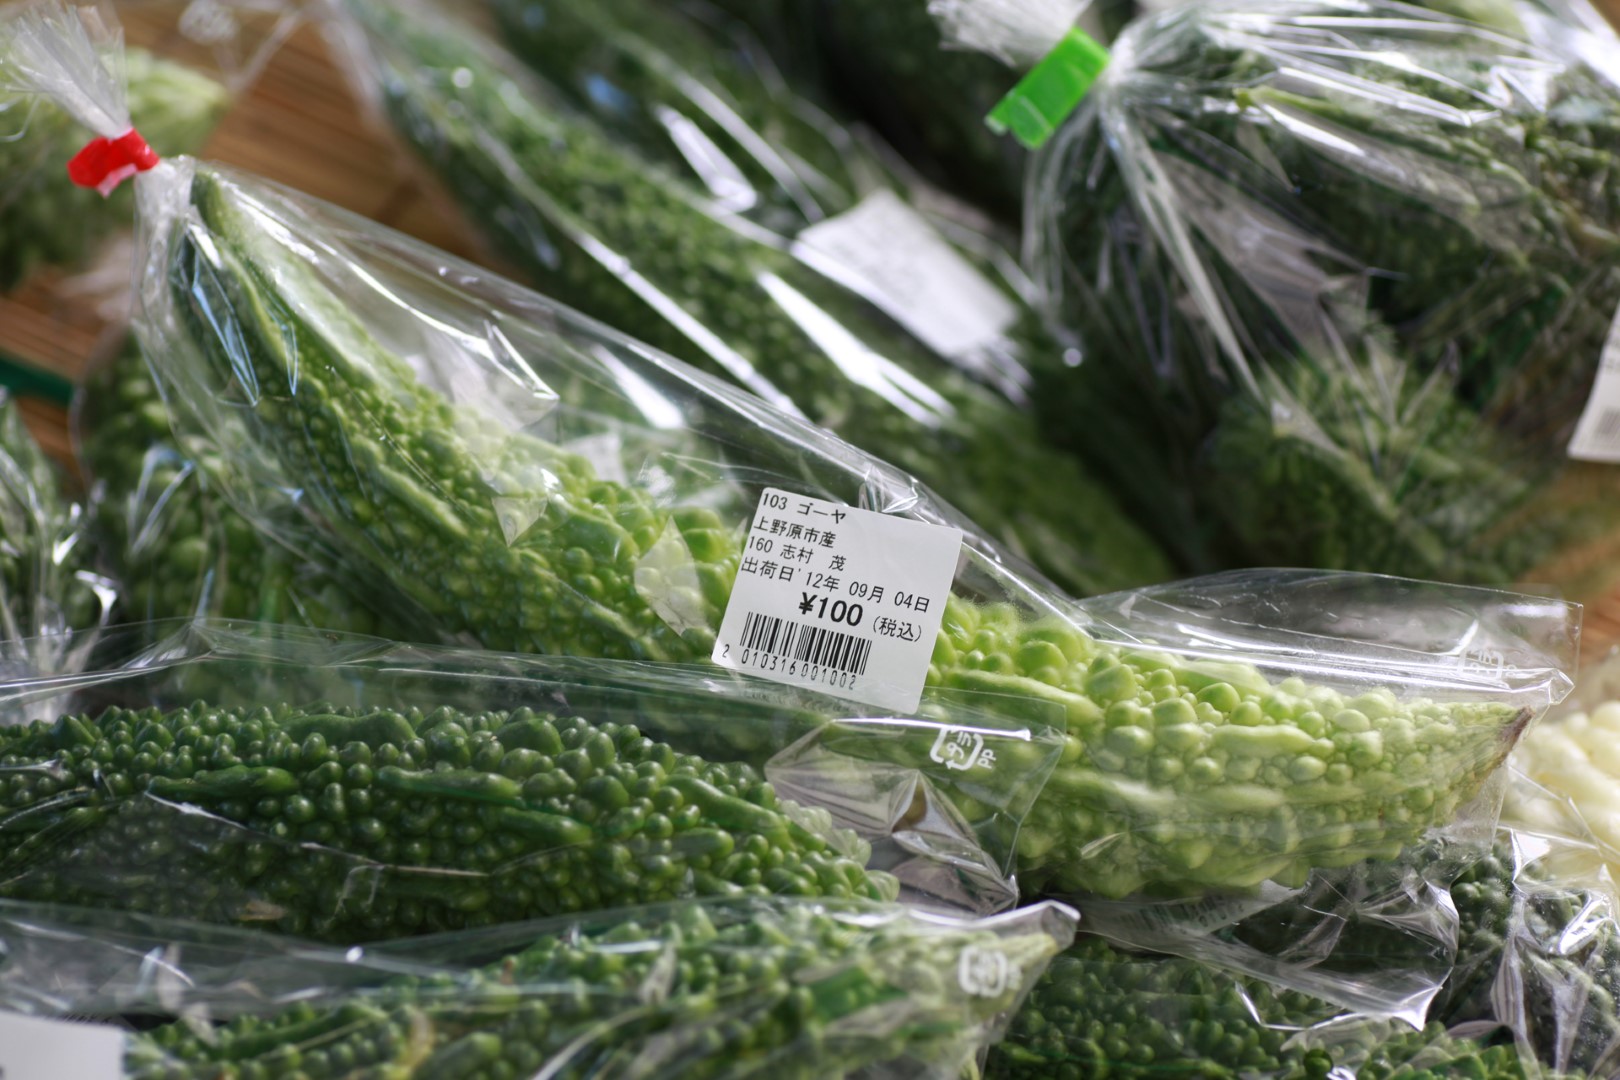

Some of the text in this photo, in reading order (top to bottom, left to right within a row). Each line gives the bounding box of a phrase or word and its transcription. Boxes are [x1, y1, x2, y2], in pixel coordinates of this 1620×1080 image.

[763, 493, 847, 524] 103 ゴーヤ
[753, 516, 836, 549] 上野原市産
[748, 535, 847, 572] 160 志村 茂
[798, 592, 863, 627] ¥100
[848, 581, 884, 603] 09月
[894, 591, 930, 613] 04日
